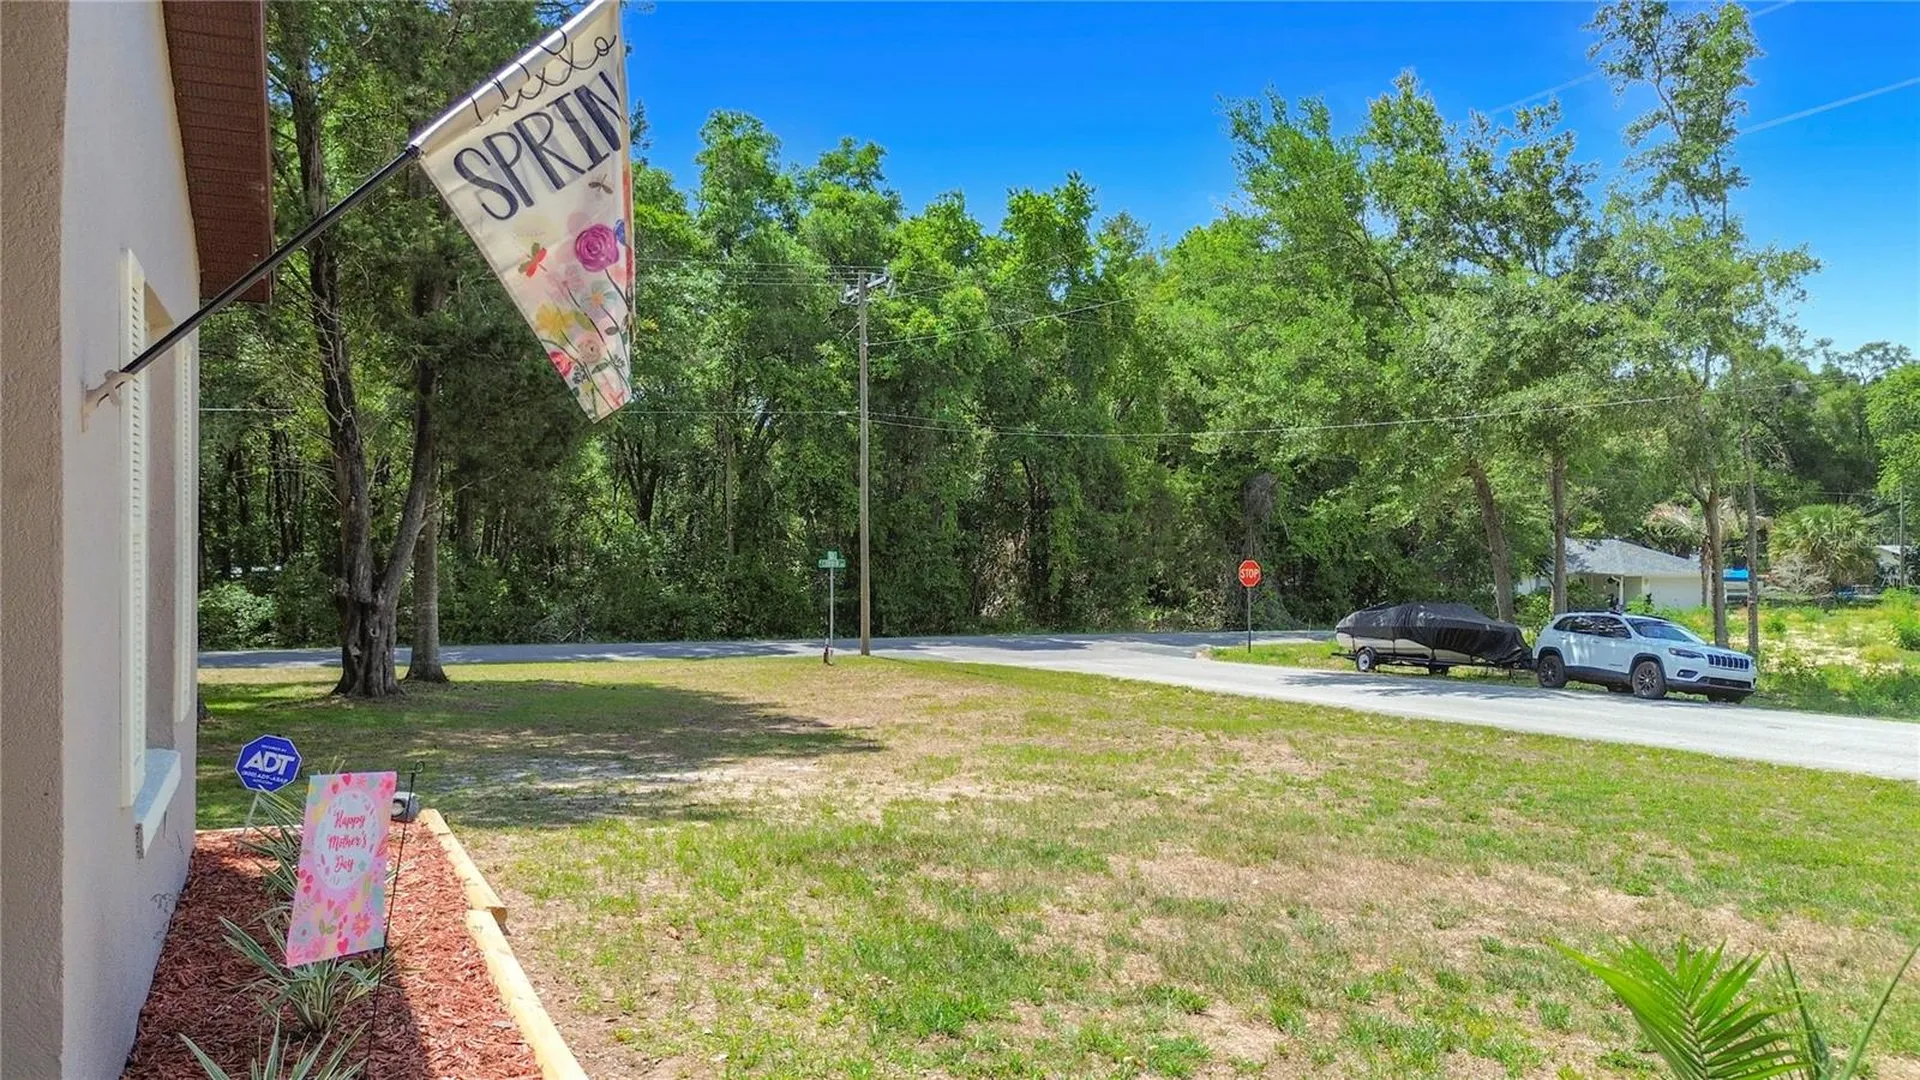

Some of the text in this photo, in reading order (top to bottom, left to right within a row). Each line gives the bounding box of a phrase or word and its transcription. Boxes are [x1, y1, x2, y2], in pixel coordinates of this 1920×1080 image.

[453, 71, 623, 221] SPRIN
[1240, 568, 1260, 579] STOP
[243, 750, 296, 775] ADT
[334, 809, 366, 829] Happy
[327, 830, 367, 851] Mother's
[334, 855, 354, 873] Day
